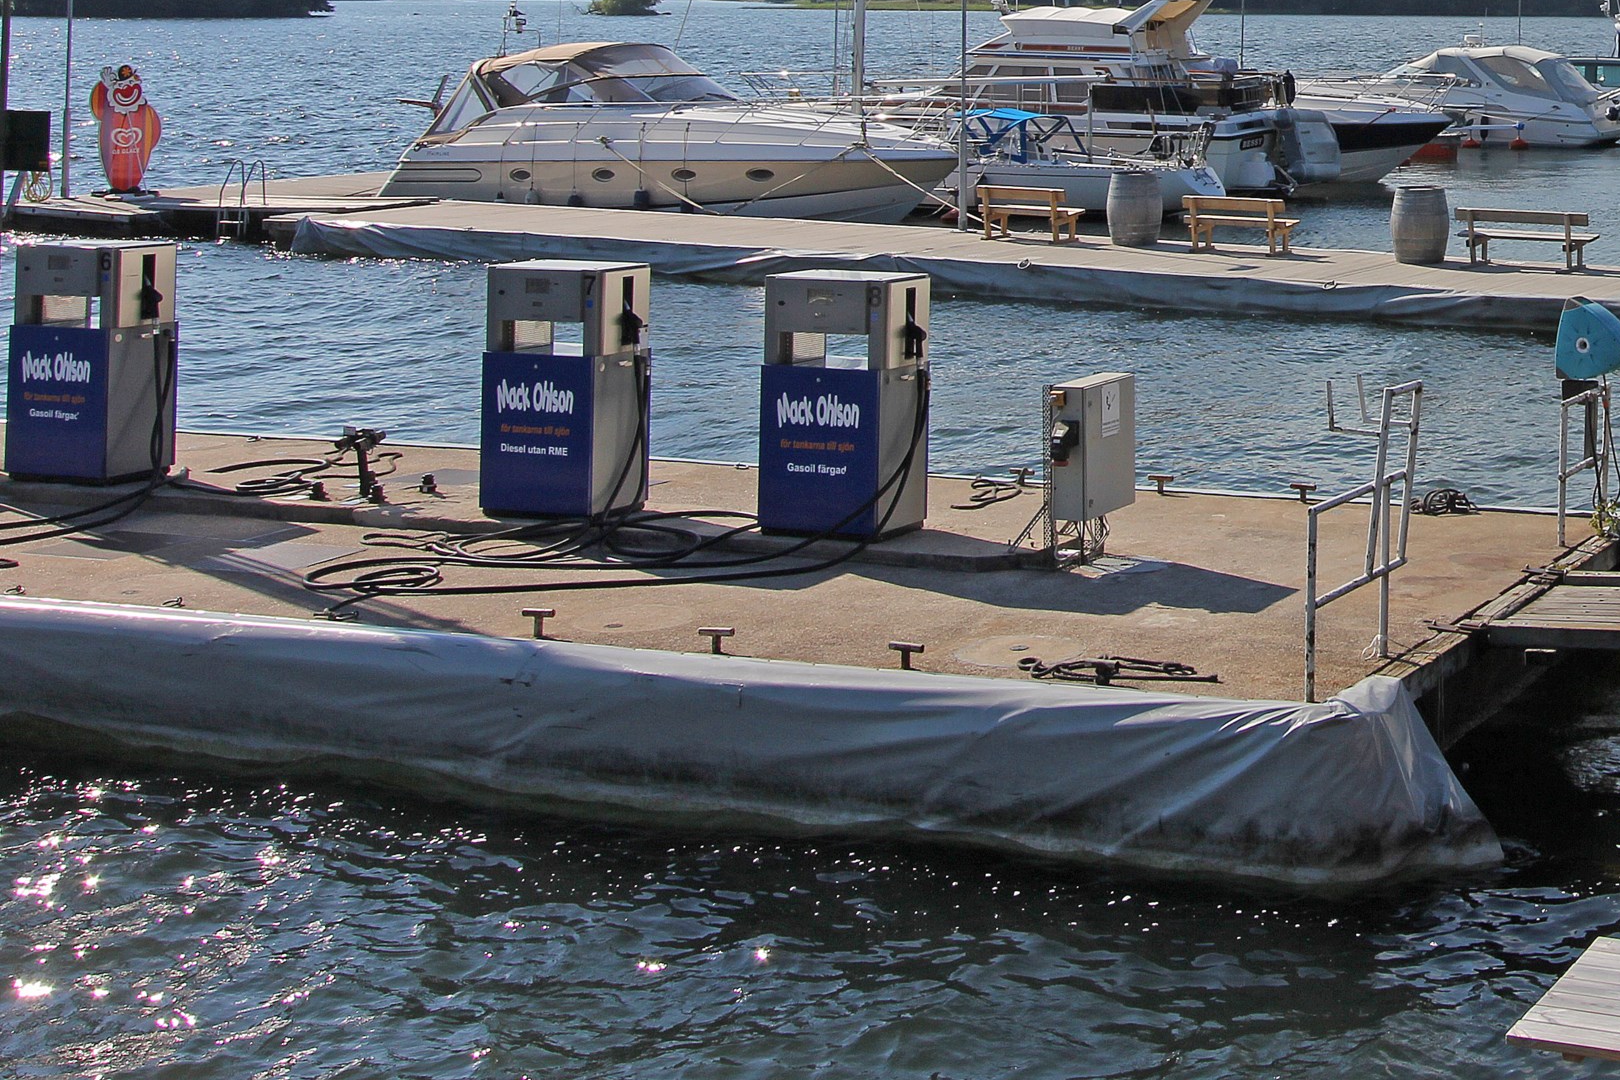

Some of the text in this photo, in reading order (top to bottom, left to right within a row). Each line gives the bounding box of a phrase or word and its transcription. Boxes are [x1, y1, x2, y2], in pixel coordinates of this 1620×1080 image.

[1242, 138, 1263, 148] BESSY
[100, 252, 112, 271] 6
[584, 275, 596, 296] 7
[870, 286, 882, 308] 8
[22, 350, 90, 384] Mack Ohlson
[497, 378, 574, 414] Mack Ohlson
[30, 408, 54, 418] Gasoil
[776, 392, 860, 429] Mack Ohlson
[500, 443, 568, 456] Diesel utan RME
[787, 462, 847, 476] Gasoil färgad
